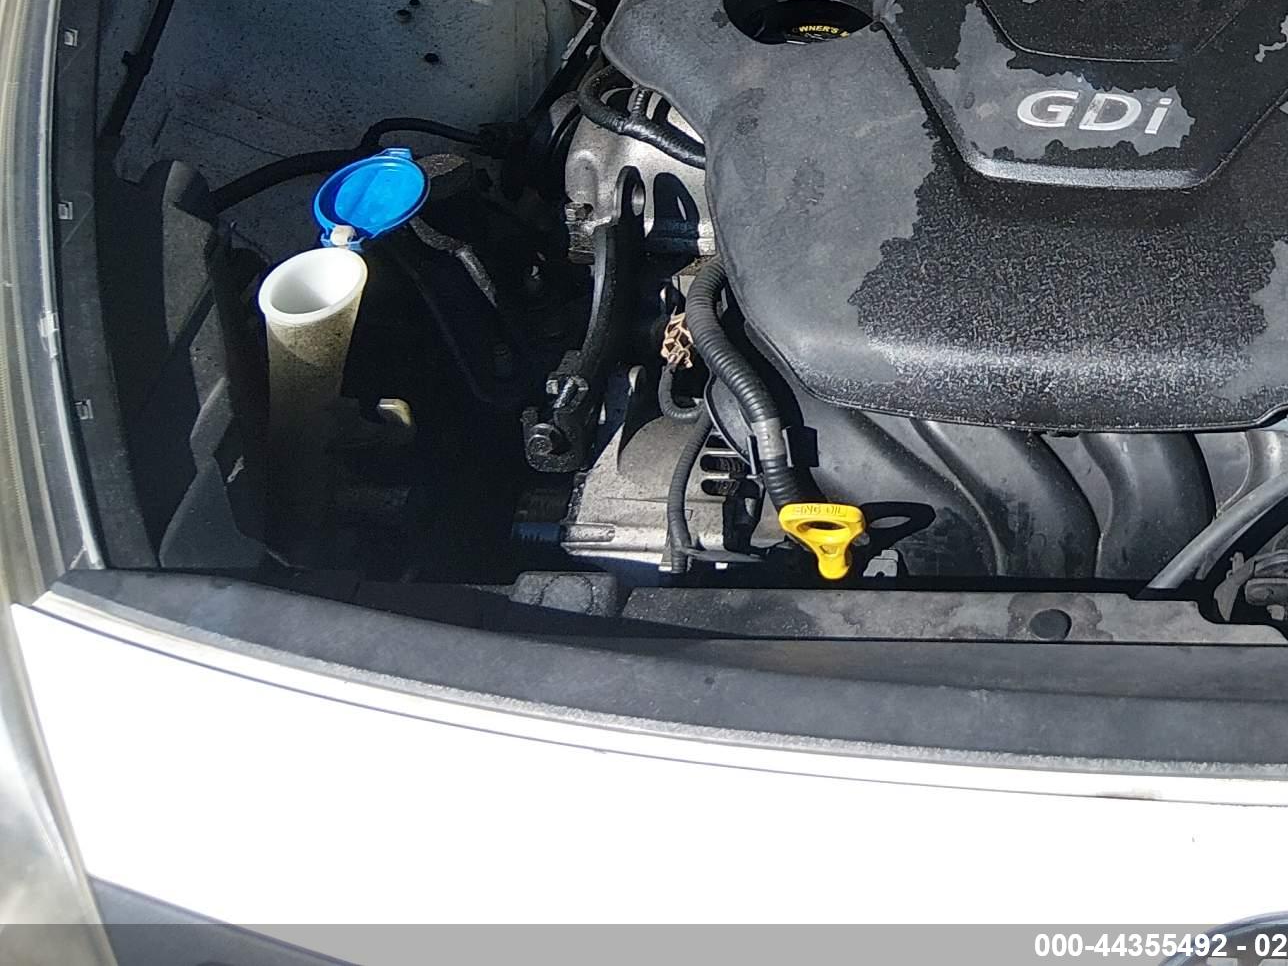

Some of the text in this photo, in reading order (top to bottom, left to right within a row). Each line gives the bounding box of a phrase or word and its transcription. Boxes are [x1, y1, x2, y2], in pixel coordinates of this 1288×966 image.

[1017, 90, 1173, 135] GDi
[793, 505, 846, 516] ENG OIL
